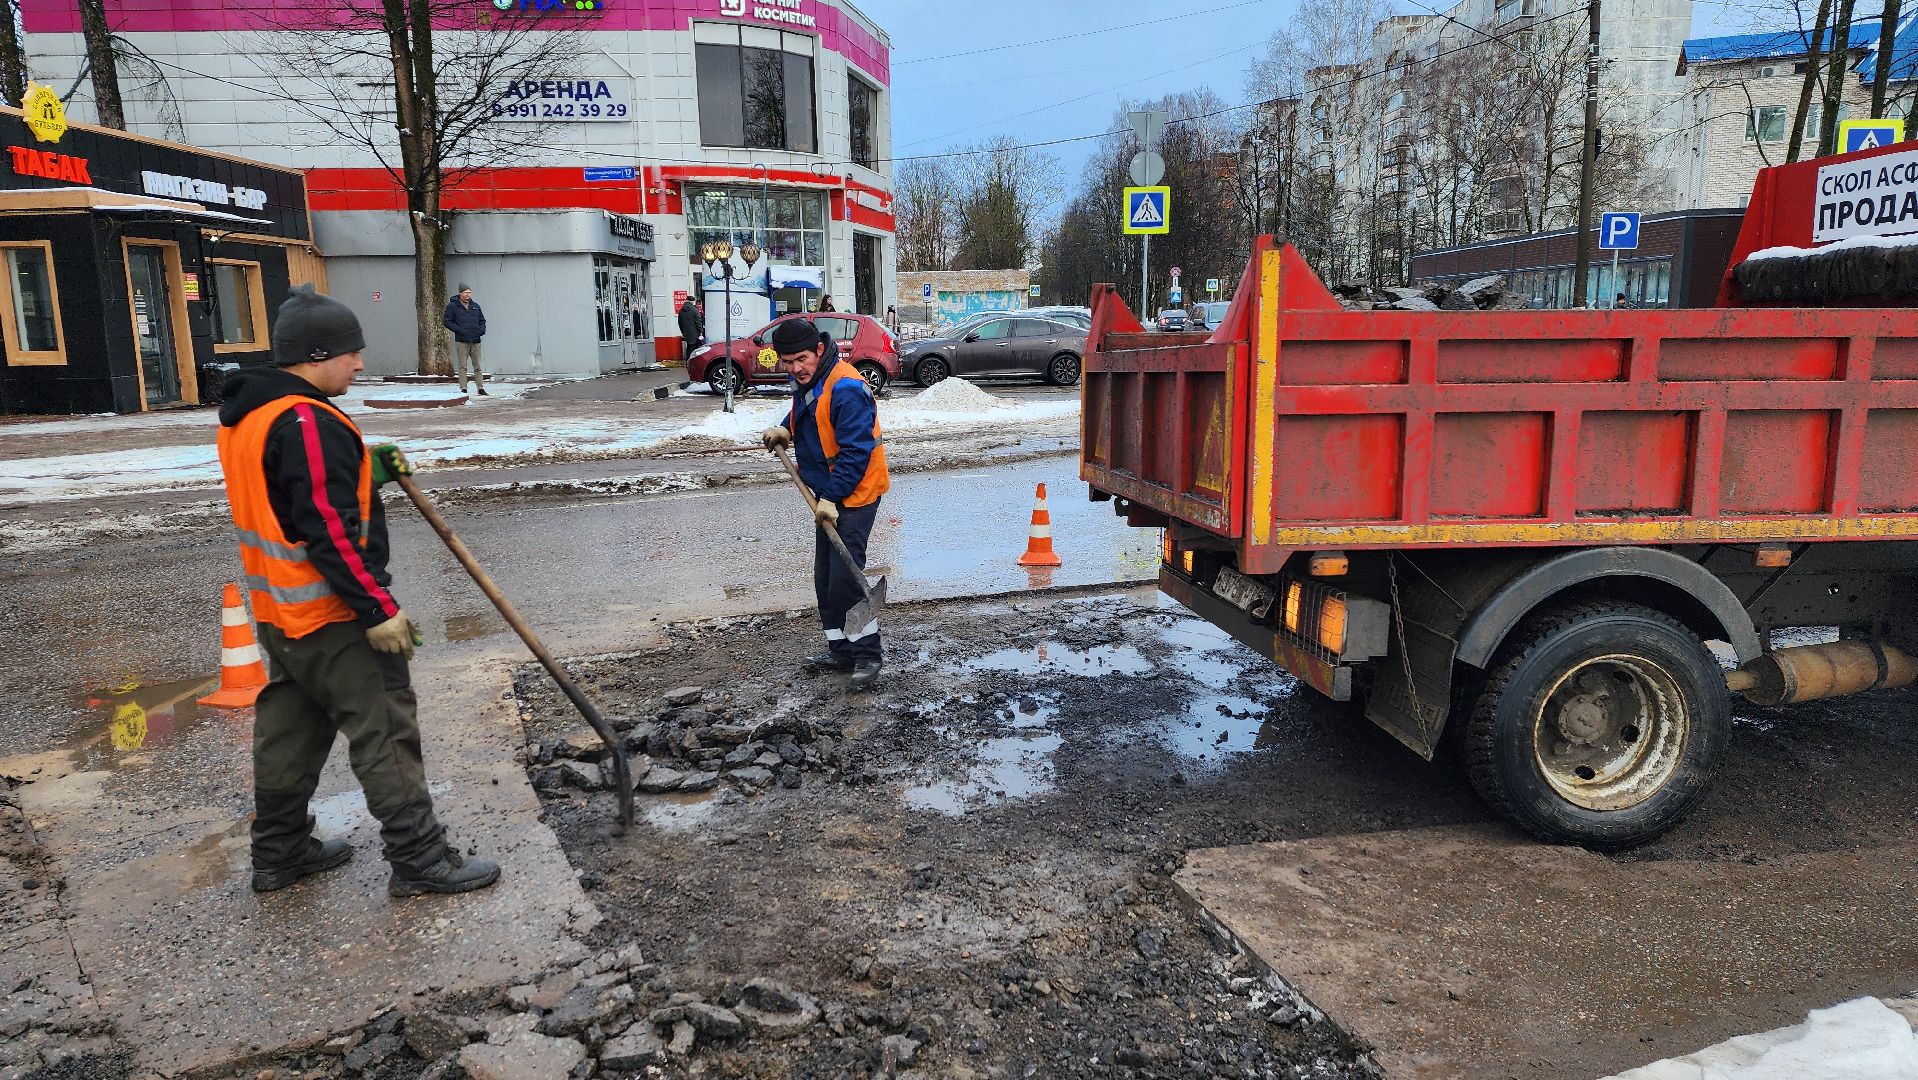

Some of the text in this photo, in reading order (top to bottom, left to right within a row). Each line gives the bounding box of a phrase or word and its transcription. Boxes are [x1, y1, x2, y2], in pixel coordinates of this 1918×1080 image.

[753, 7, 816, 27] КОСМЕТИК
[502, 80, 612, 101] АРЕНДА
[508, 103, 537, 118] 991
[543, 103, 574, 117] 242
[580, 103, 601, 117] 39
[606, 103, 627, 117] 29
[7, 145, 93, 185] ТАБАК
[141, 170, 267, 211] МАГАЗИН-БАР
[1822, 169, 1872, 196] СКОЛ
[1608, 216, 1632, 246] P
